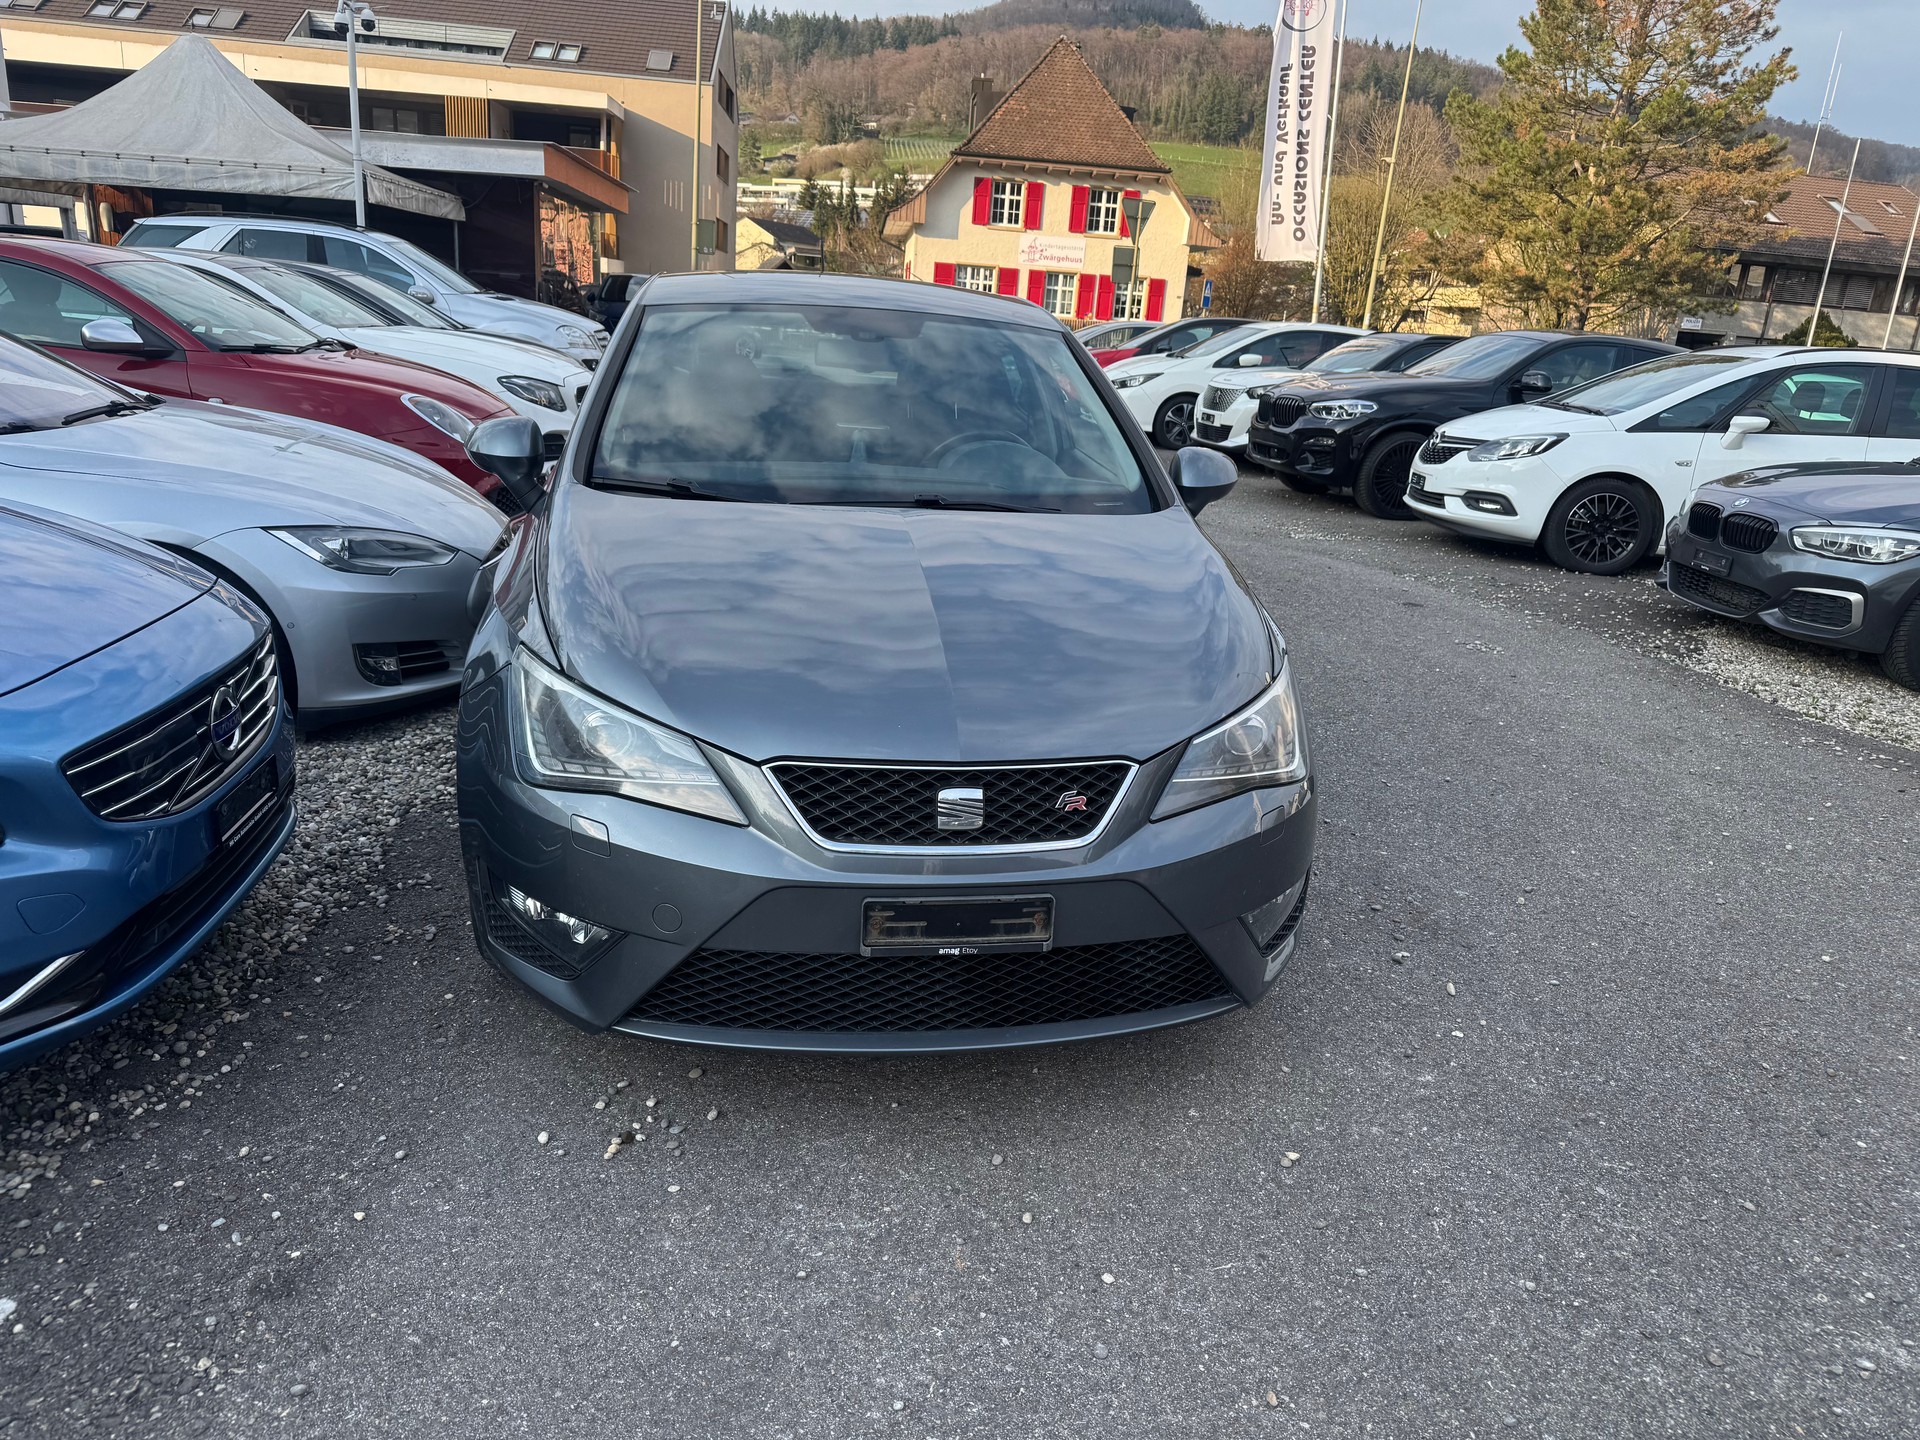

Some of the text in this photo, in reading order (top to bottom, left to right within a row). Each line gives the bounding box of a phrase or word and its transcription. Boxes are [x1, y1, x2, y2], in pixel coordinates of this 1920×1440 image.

[1038, 253, 1083, 263] Zwärgehuus
[1055, 790, 1087, 811] FR
[938, 947, 960, 956] amag
